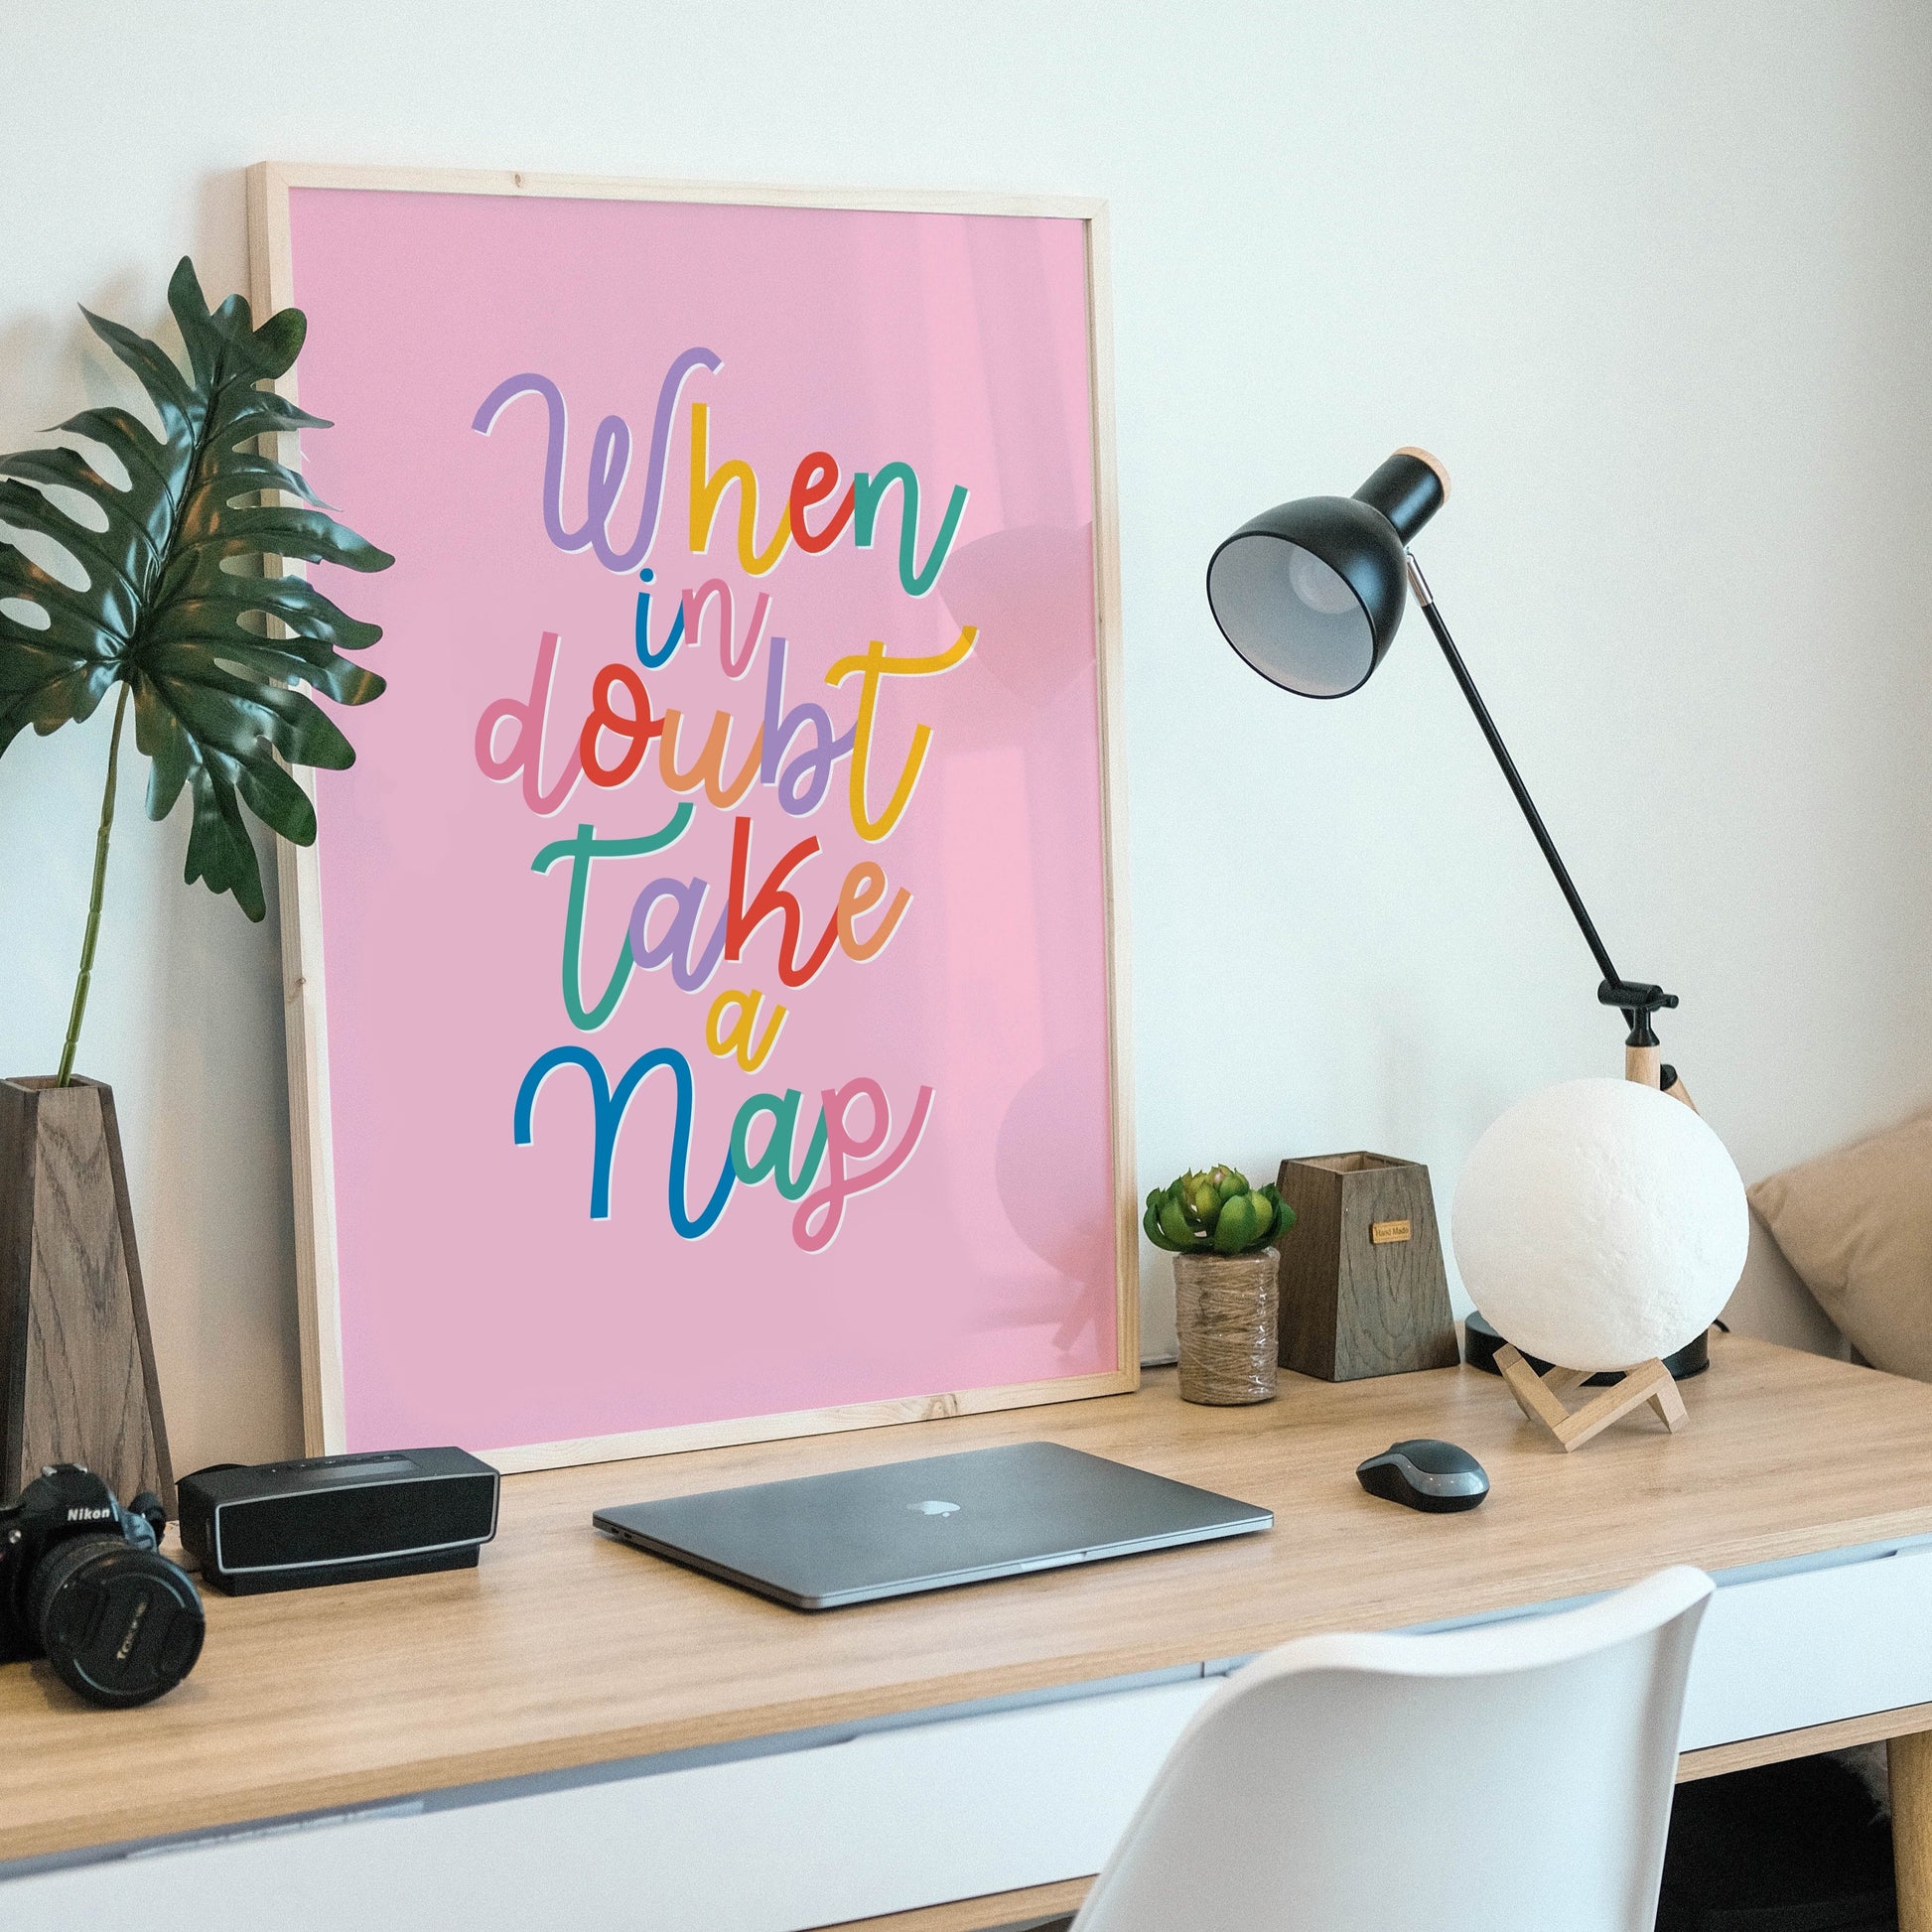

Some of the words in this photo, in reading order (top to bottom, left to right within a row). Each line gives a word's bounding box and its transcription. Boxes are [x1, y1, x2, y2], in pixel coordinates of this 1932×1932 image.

[472, 347, 970, 597] When
[635, 568, 769, 679] in
[475, 625, 979, 842] doubt
[530, 802, 914, 1032] take
[706, 989, 789, 1074] a
[67, 1507, 110, 1521] Nikon
